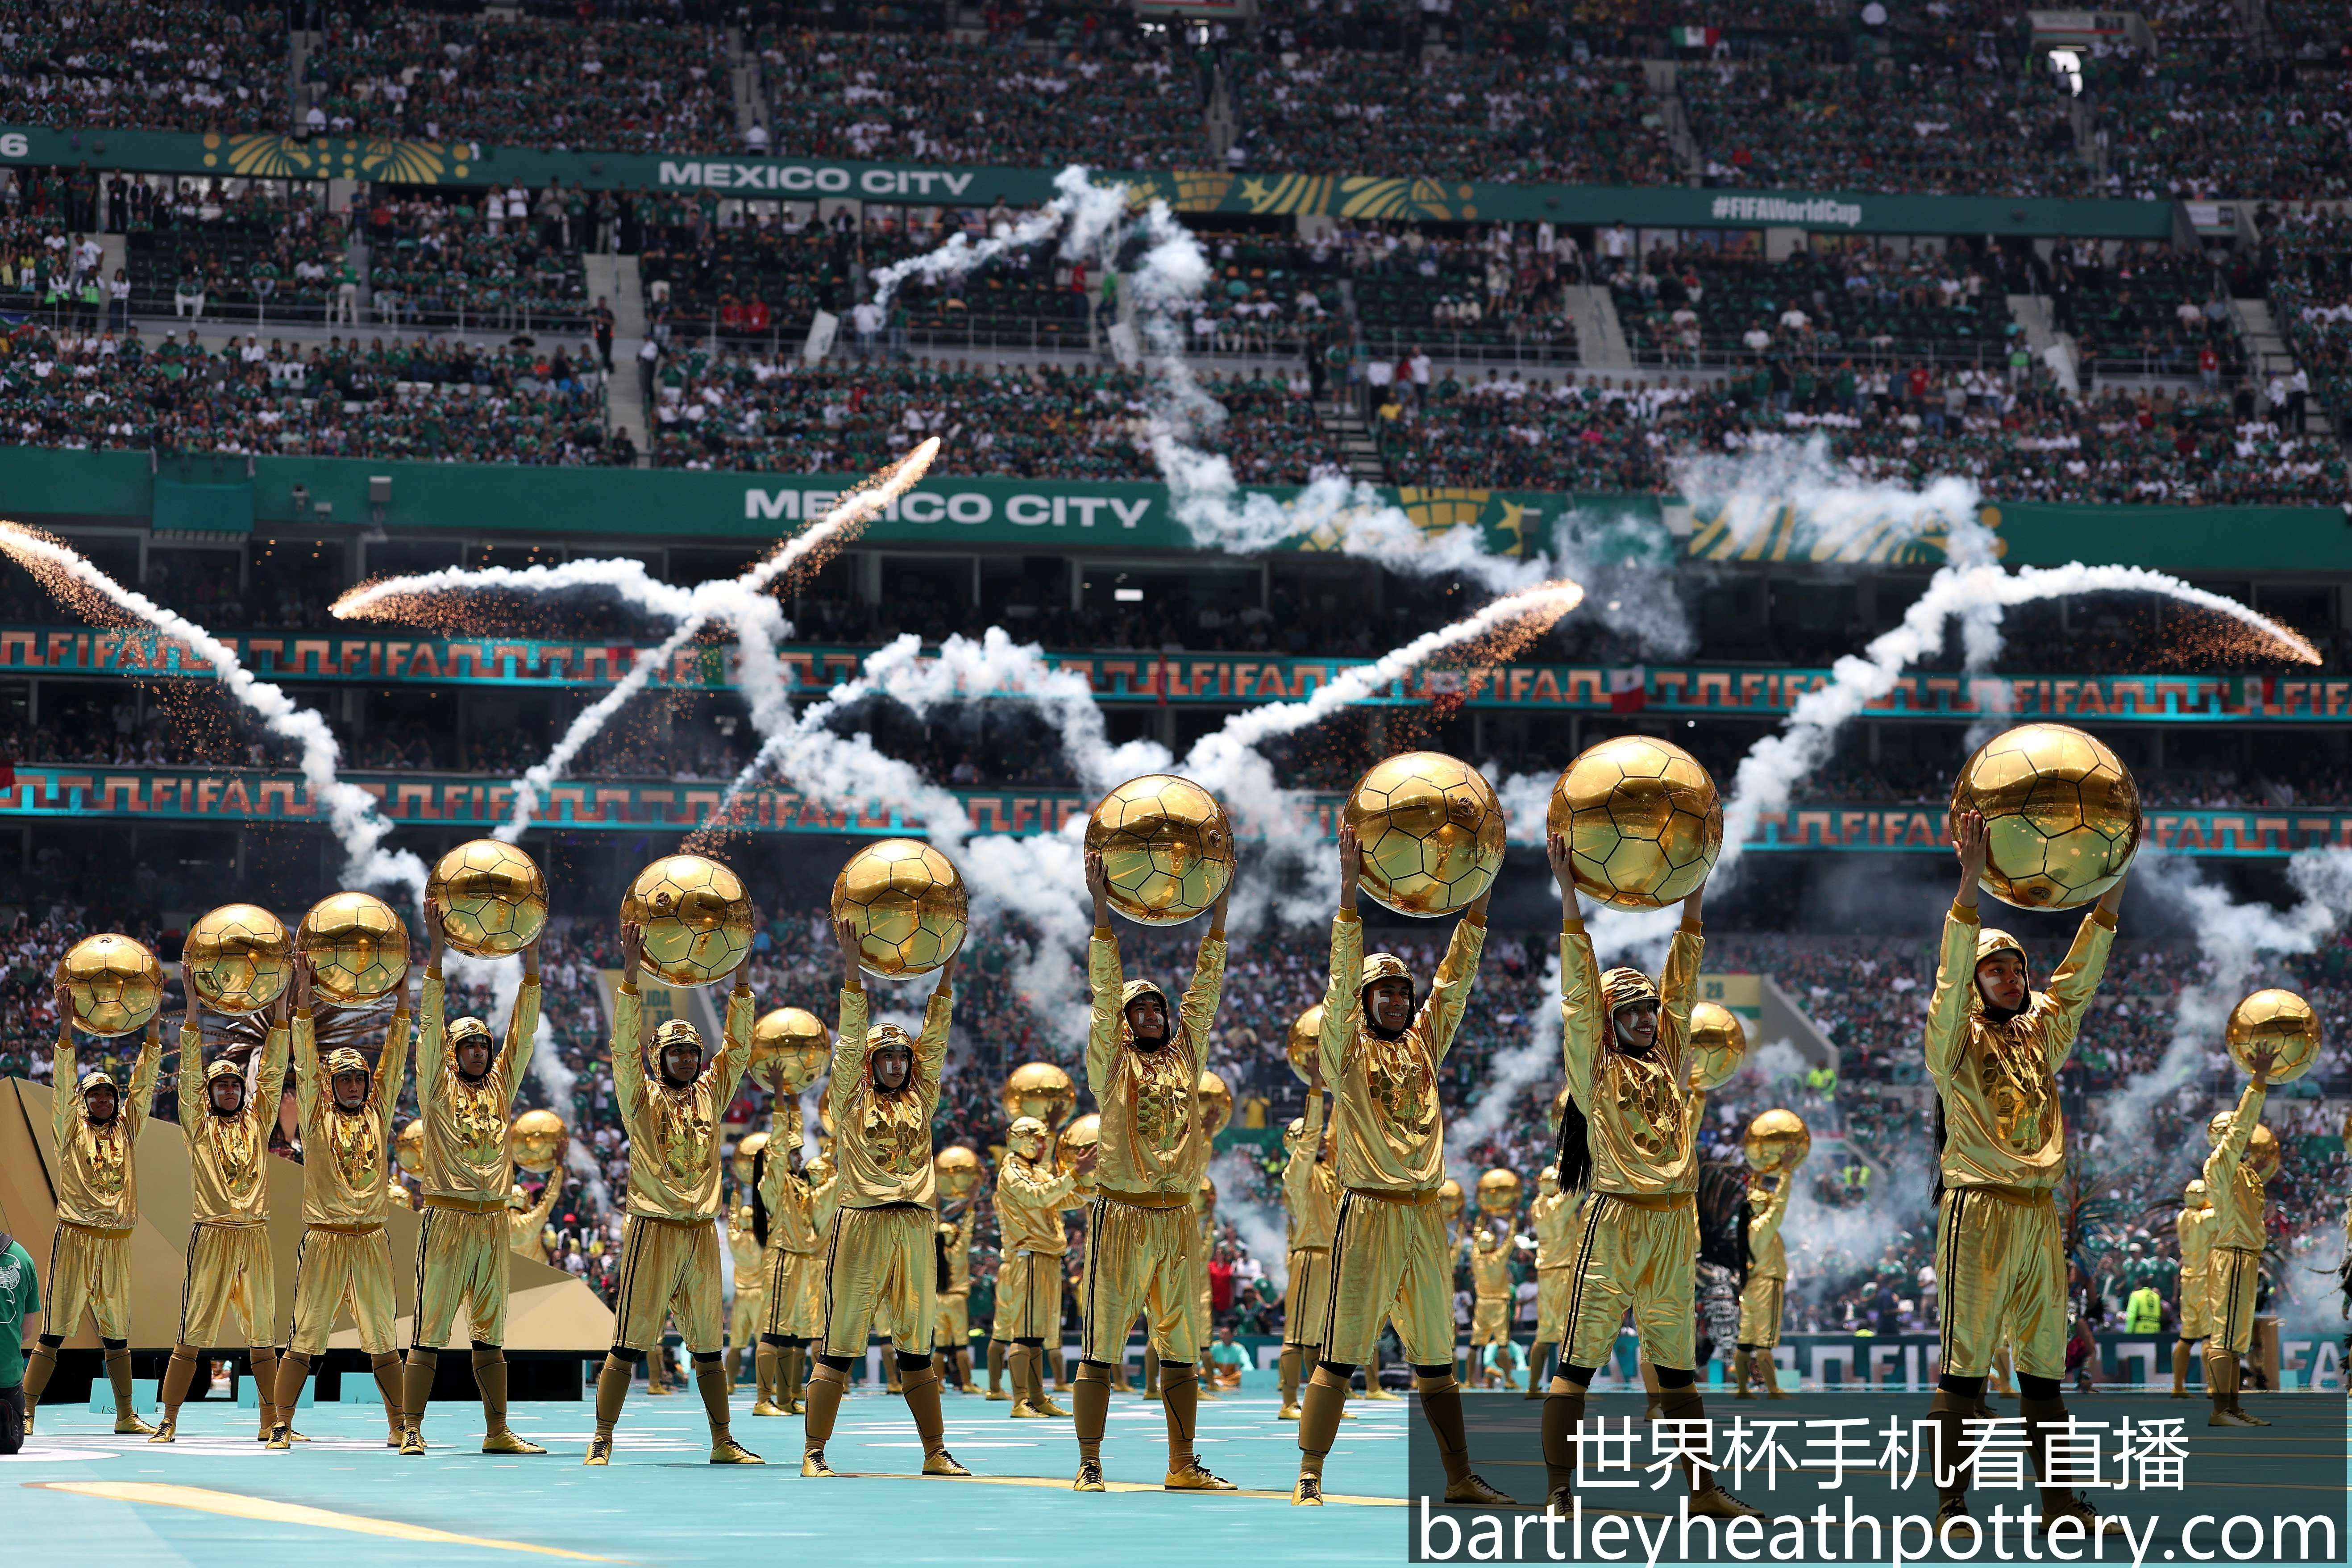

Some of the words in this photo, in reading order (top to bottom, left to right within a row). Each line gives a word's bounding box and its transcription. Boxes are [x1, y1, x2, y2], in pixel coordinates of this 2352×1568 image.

[0, 133, 29, 158] 6
[659, 160, 851, 192] MEXICO
[860, 168, 974, 196] CITY
[1712, 196, 1862, 228] #FIFAWorldCup
[1005, 494, 1151, 528] CITY
[48, 632, 150, 668] FIFA
[341, 641, 440, 676] FIFA
[1192, 662, 1288, 696] FIFA
[1467, 668, 1563, 703] FIFA
[2013, 679, 2107, 713] FIFA
[2283, 682, 2352, 715] FIF
[152, 778, 252, 814] FIFA
[1013, 798, 1094, 832] FIF
[1841, 812, 1936, 846] FIFA
